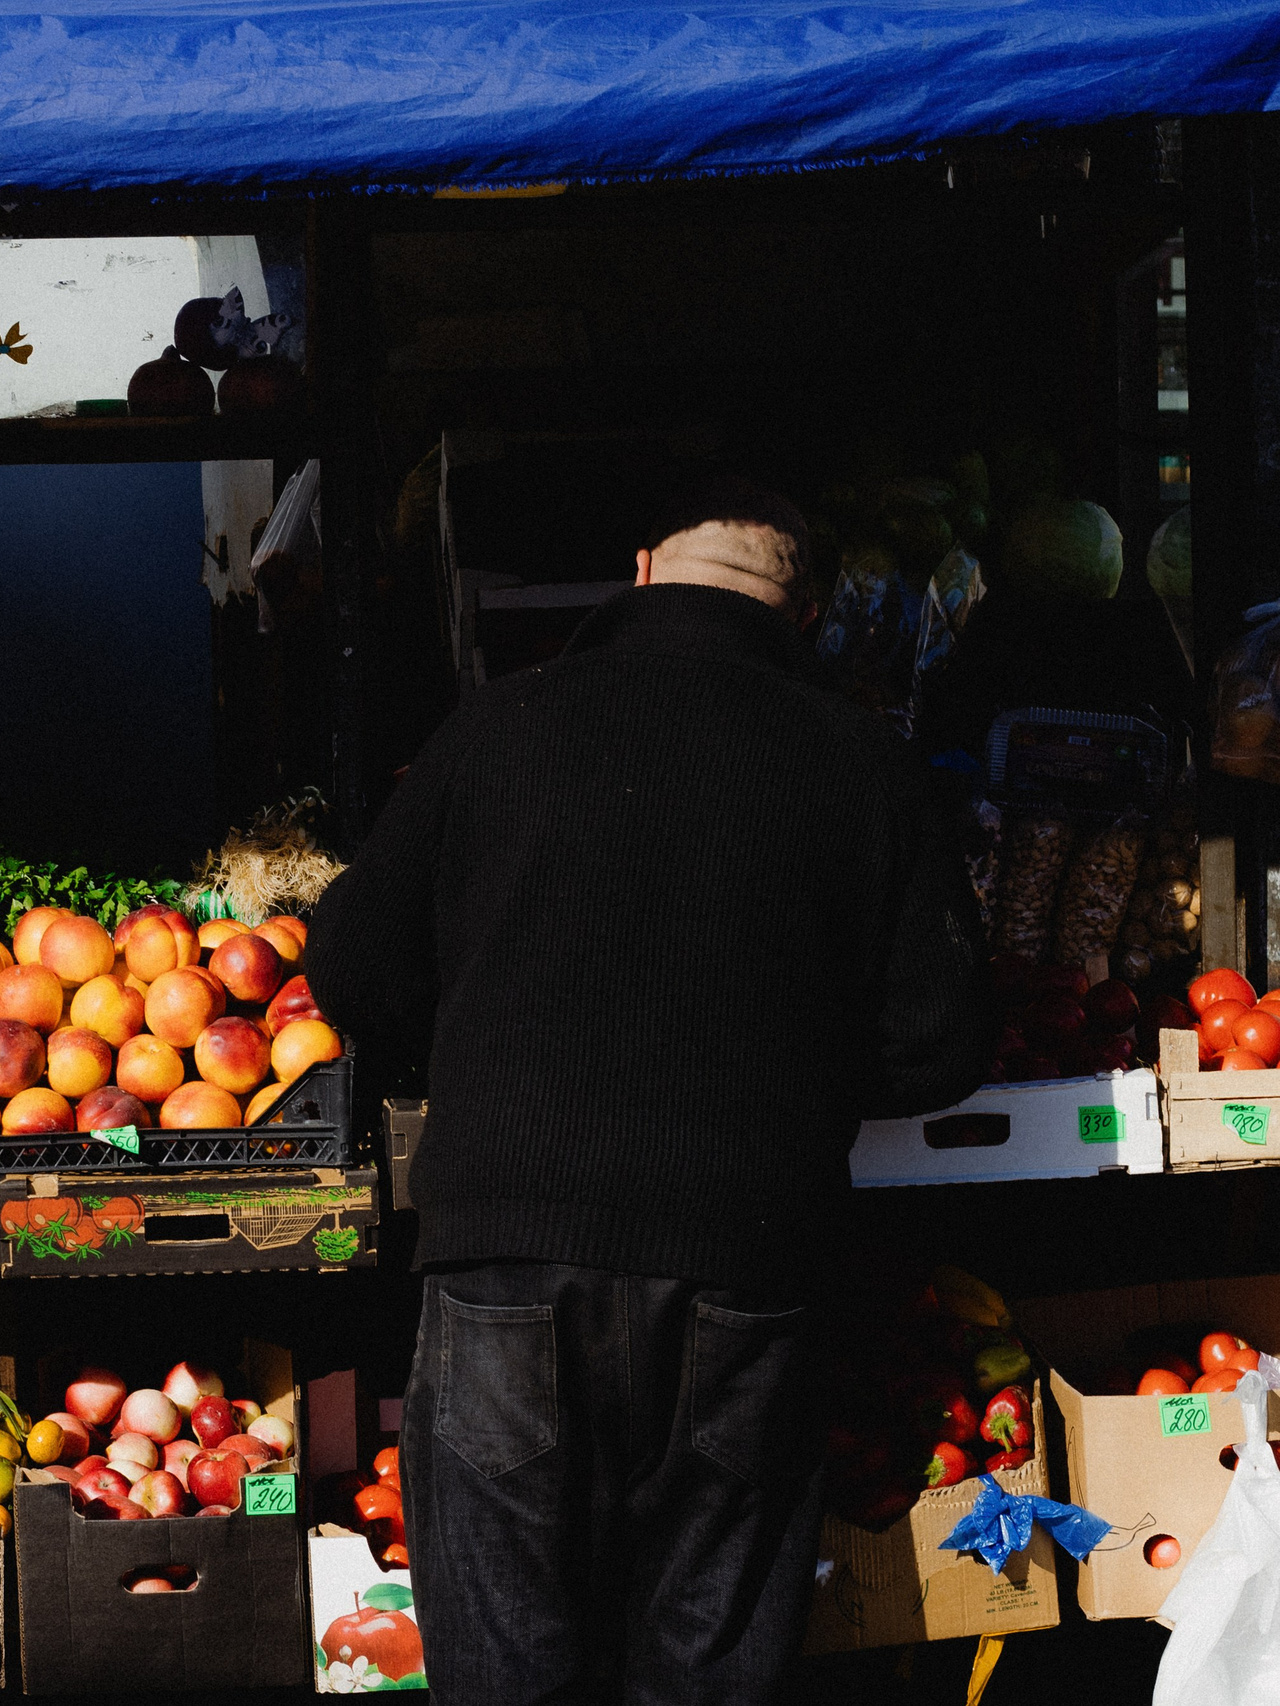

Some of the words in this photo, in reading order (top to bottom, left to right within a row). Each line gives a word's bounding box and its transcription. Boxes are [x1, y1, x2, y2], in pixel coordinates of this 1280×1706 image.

[1081, 1114, 1113, 1136] 330
[1170, 1408, 1206, 1433] 280
[252, 1487, 292, 1512] 240
